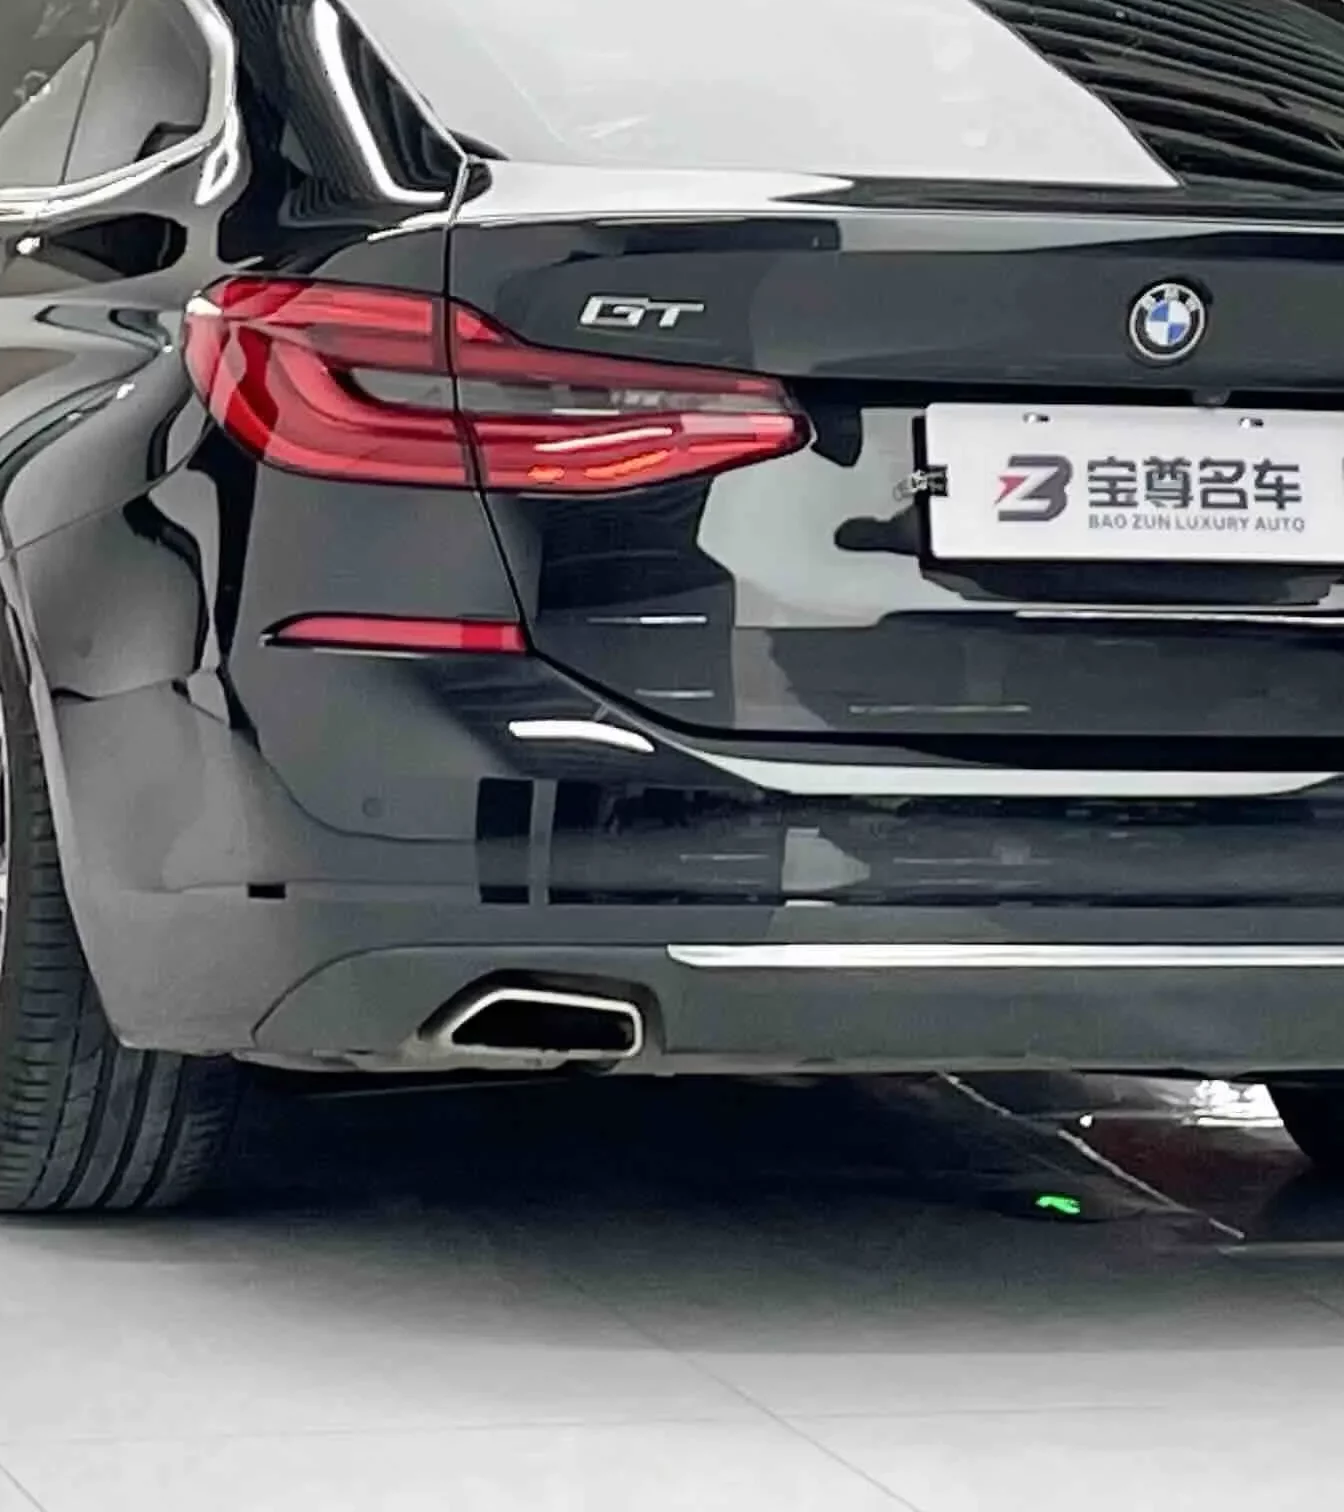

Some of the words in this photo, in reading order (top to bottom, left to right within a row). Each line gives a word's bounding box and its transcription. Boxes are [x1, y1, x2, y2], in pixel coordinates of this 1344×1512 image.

[580, 295, 705, 329] GT
[1086, 455, 1303, 511] 宝尊名车
[1087, 513, 1128, 530] BAO
[1131, 513, 1172, 530] ZUN
[1175, 514, 1249, 531] LUXURY
[1254, 515, 1306, 532] AUTO
